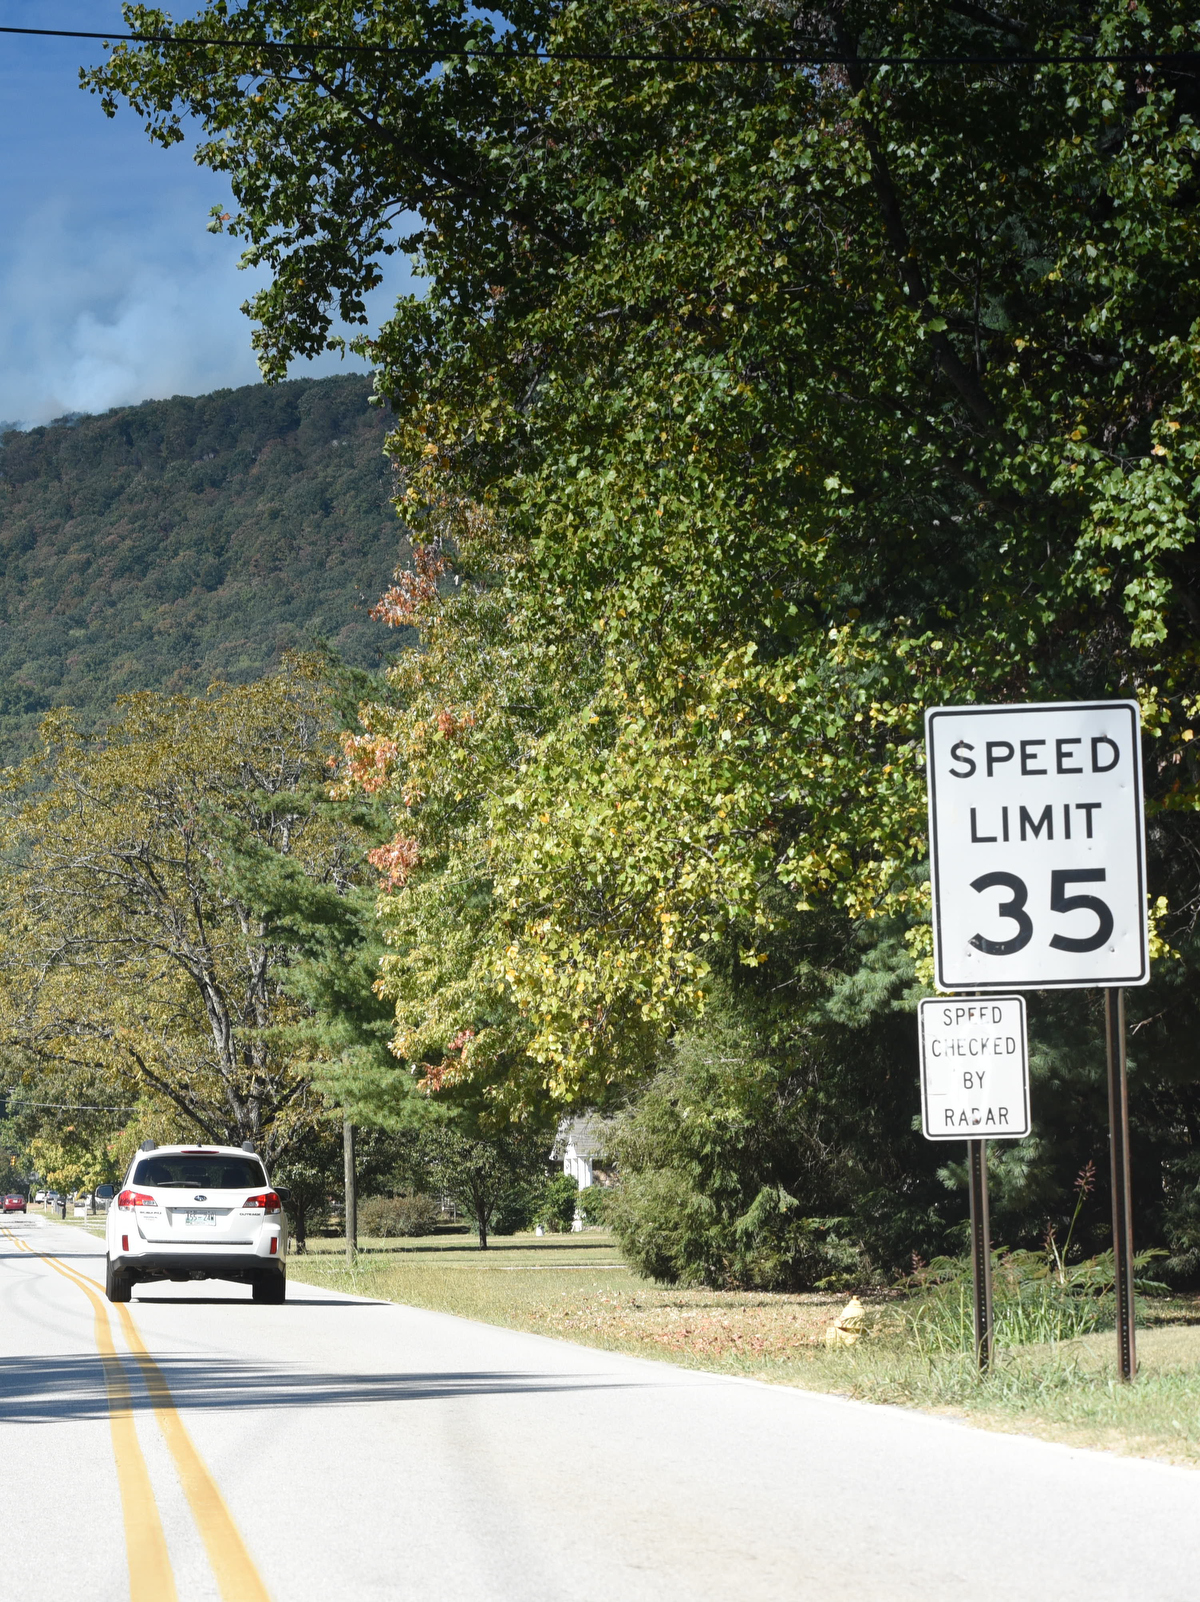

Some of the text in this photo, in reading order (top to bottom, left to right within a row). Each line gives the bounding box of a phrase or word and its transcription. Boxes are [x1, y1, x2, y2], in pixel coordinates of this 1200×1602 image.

[948, 736, 1120, 779] SPEED
[970, 802, 1102, 843] LIMIT
[967, 867, 1114, 956] 35
[943, 1006, 1003, 1026] SPEED
[931, 1036, 1016, 1057] CHECKED
[963, 1071, 985, 1089] BY
[944, 1107, 1009, 1126] RADAR
